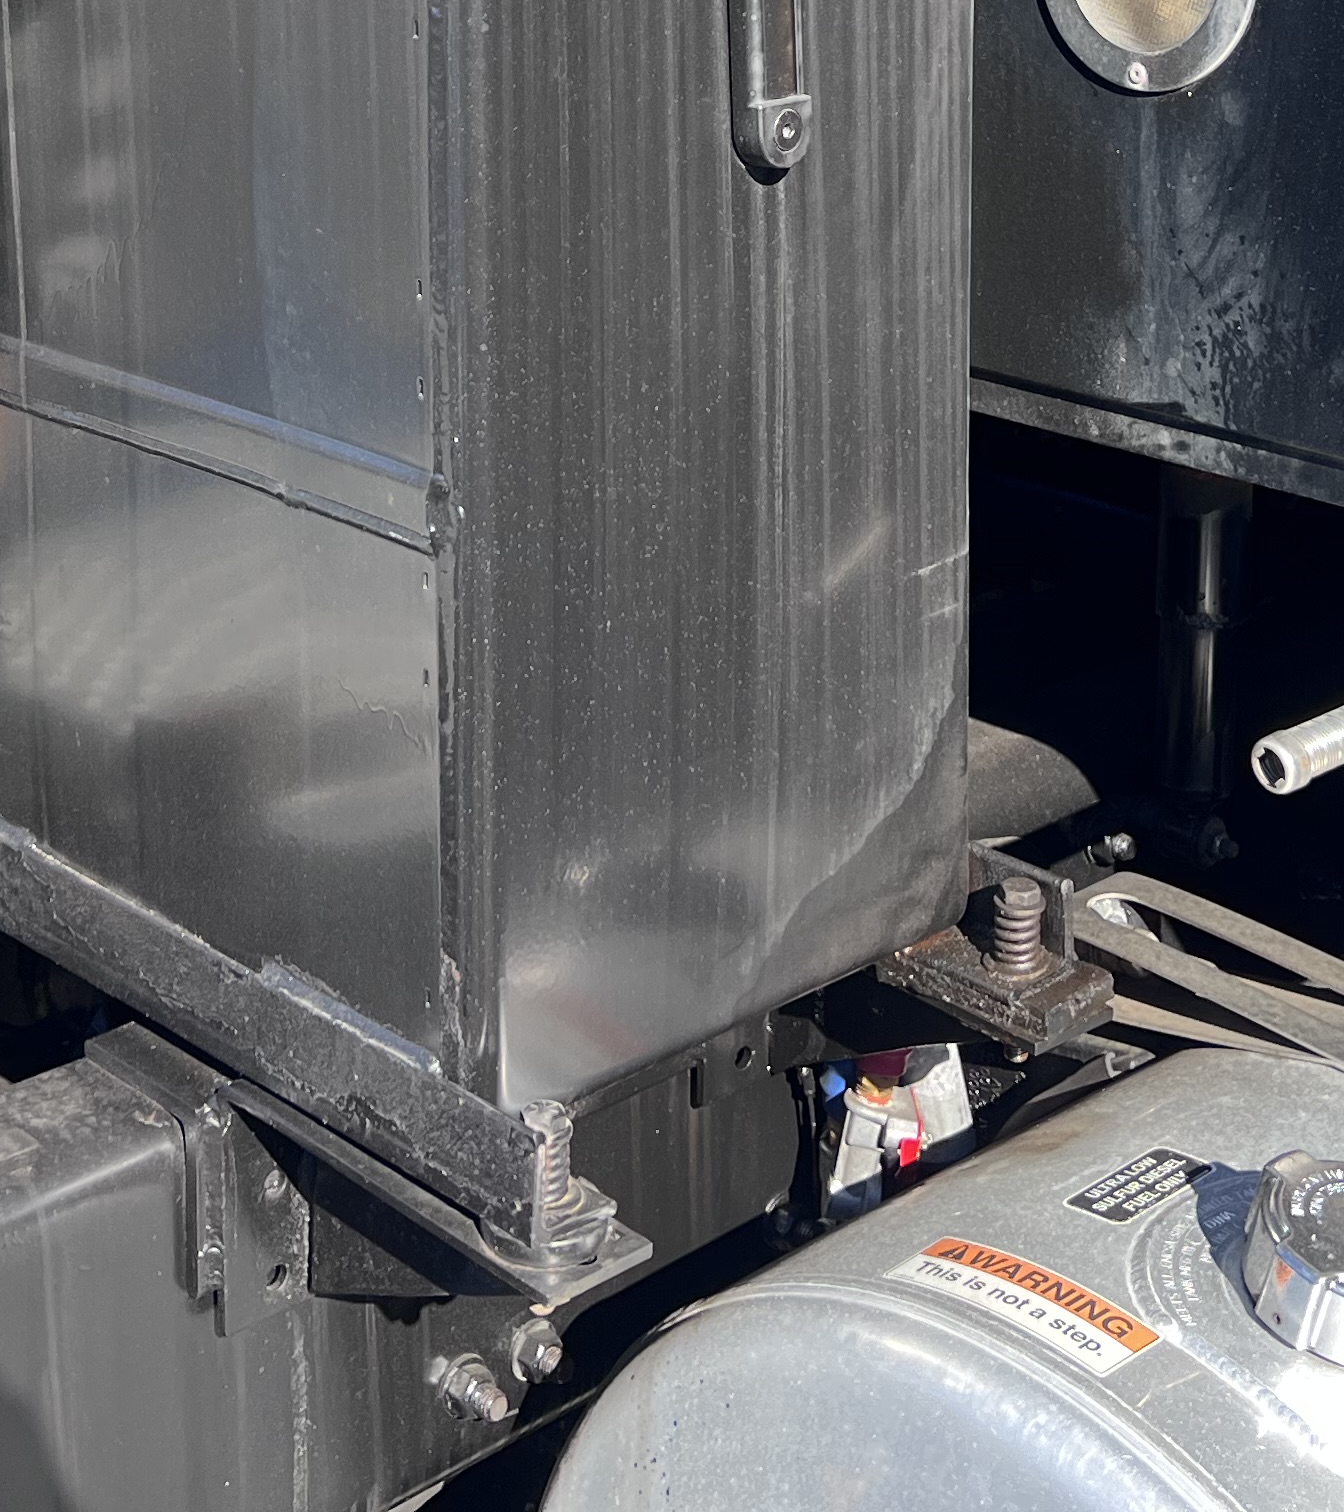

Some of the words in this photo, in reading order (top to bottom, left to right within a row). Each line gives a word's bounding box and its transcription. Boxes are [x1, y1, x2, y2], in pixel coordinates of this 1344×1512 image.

[1084, 1172, 1130, 1199] ULTRA
[1130, 1156, 1158, 1179] LOW
[1091, 1181, 1143, 1213] SULFUR
[1142, 1157, 1187, 1184] DIESEL
[1122, 1187, 1161, 1212] FUEL
[1156, 1171, 1189, 1194] ONLY
[915, 1260, 962, 1283] This
[964, 1276, 987, 1291] is
[987, 1288, 1030, 1311] not
[1028, 1306, 1047, 1320] a
[1048, 1318, 1103, 1356] step.
[969, 1250, 1134, 1339] WARNING
